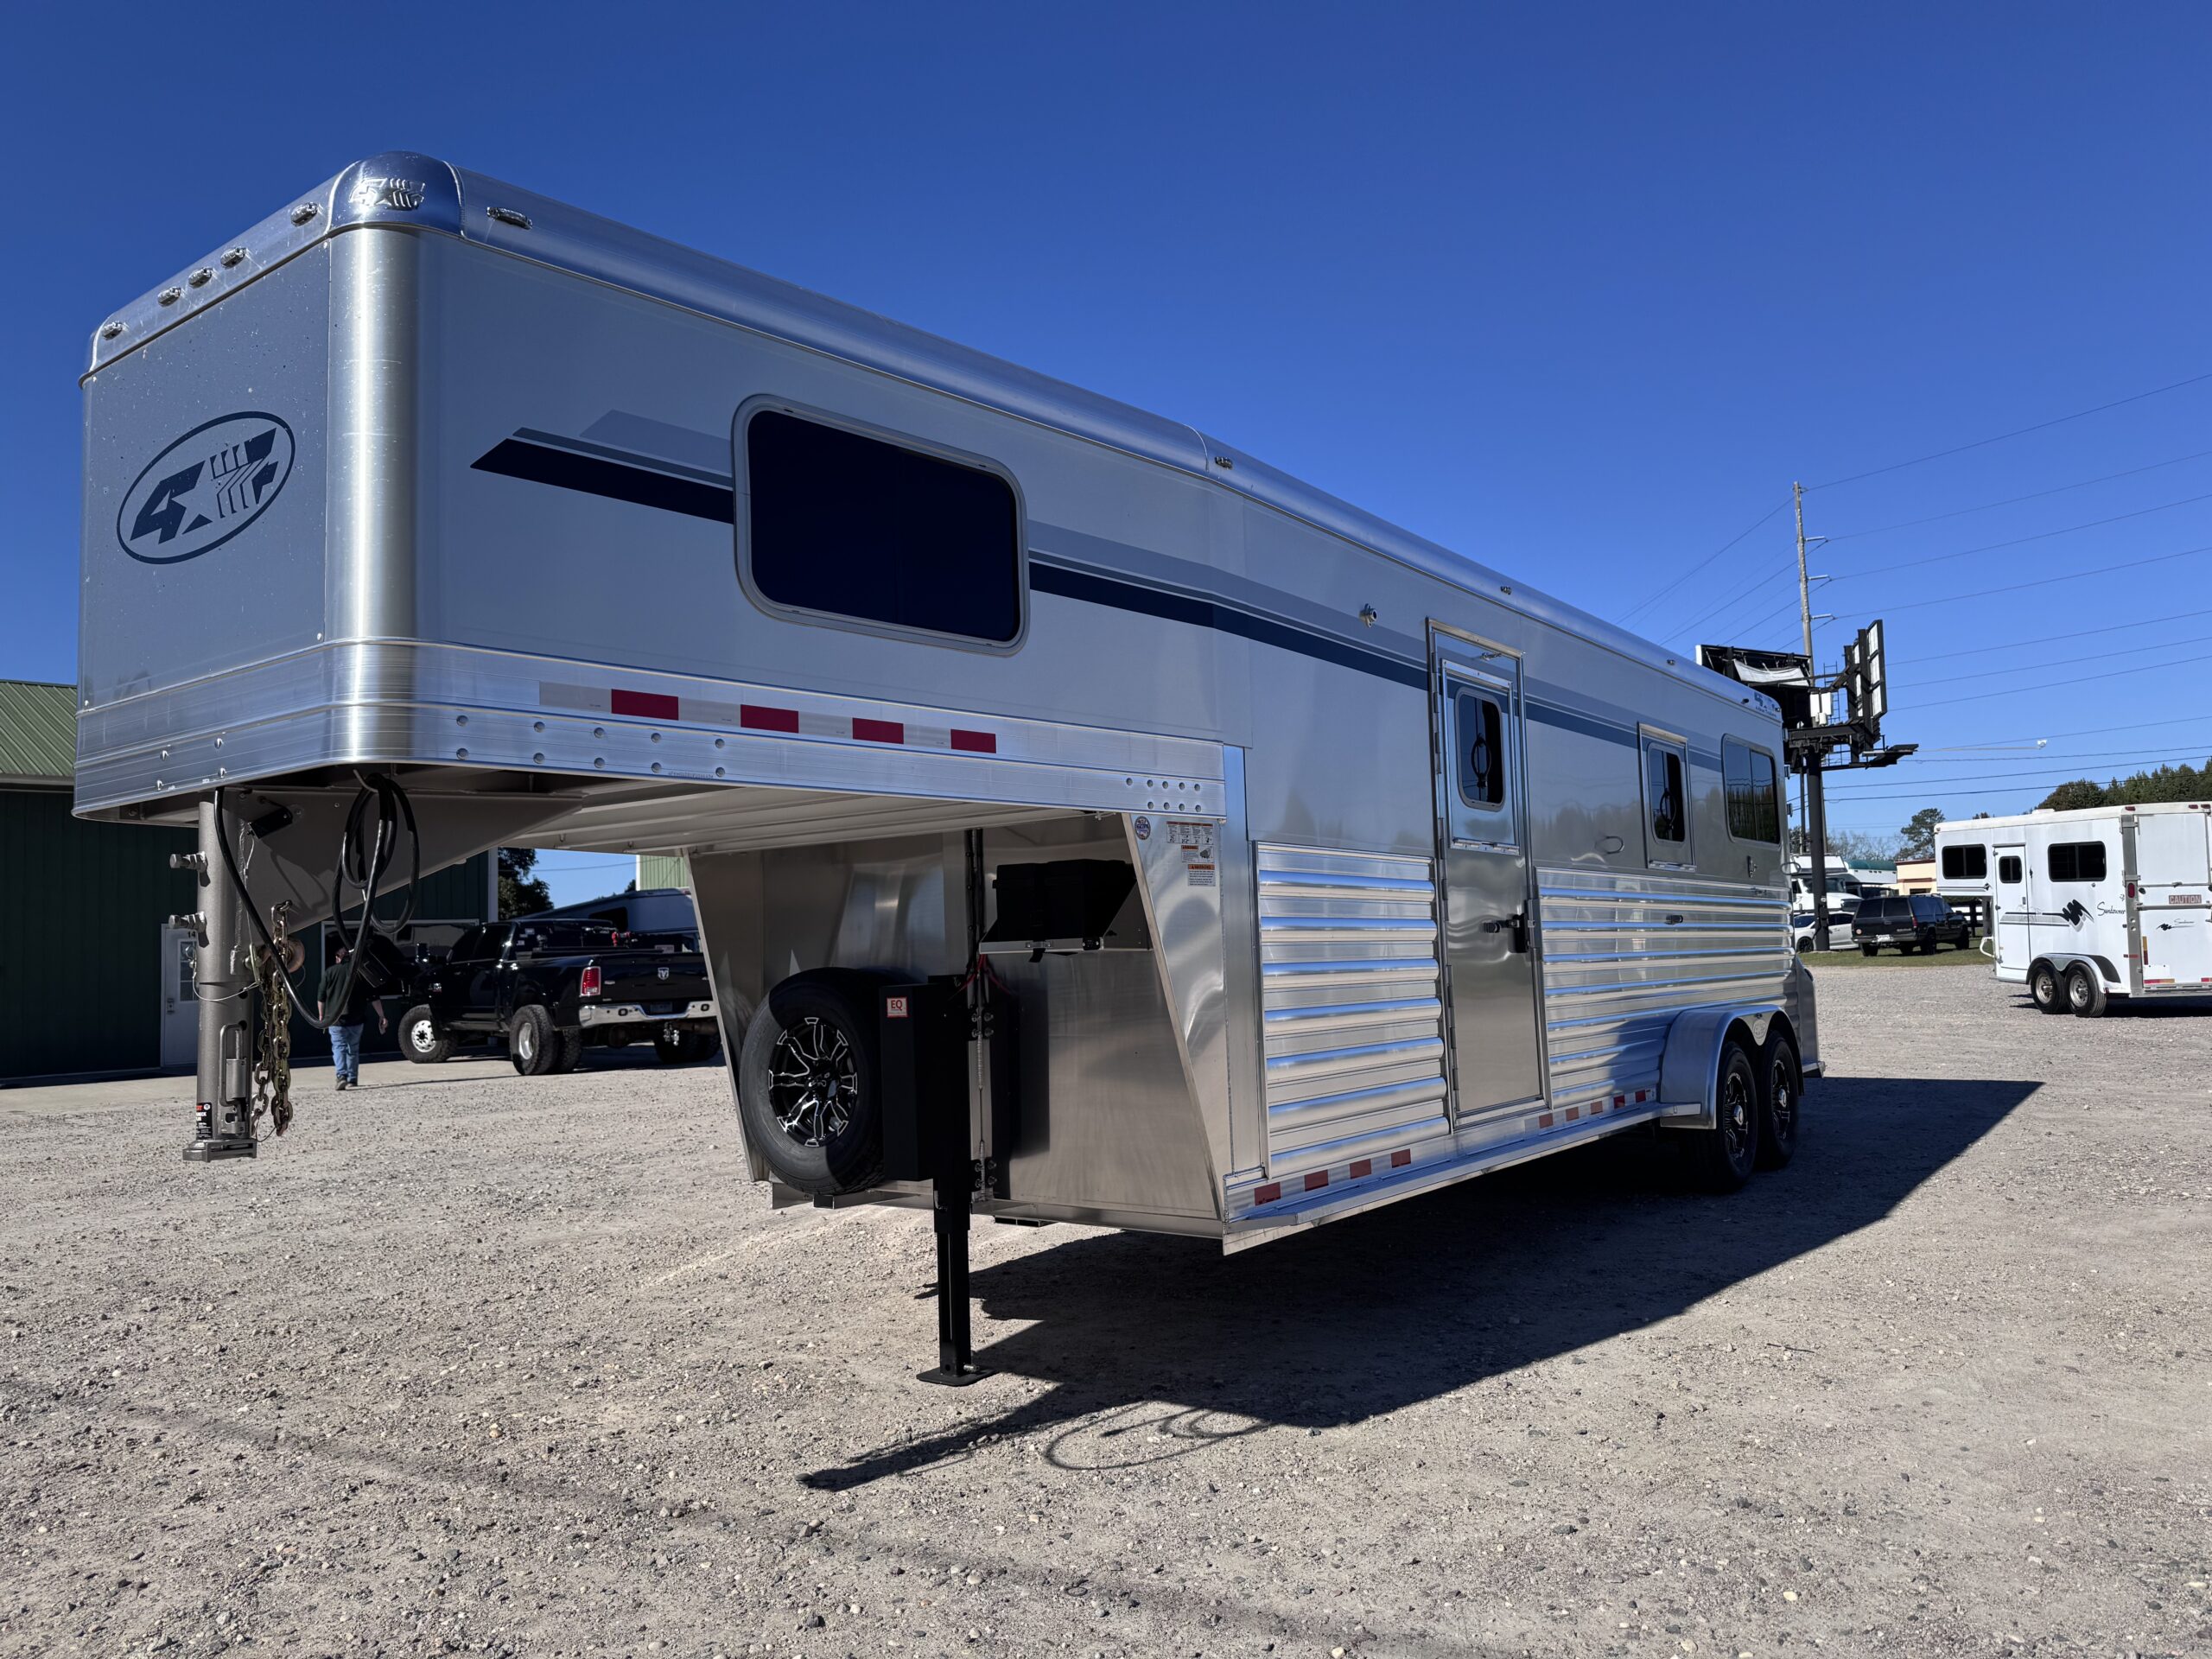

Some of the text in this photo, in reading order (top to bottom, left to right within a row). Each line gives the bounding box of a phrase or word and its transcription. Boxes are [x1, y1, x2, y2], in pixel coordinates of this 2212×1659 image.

[2170, 894, 2201, 904] CAUTION
[2096, 901, 2126, 917] Sundowner
[891, 1000, 902, 1010] EQ
